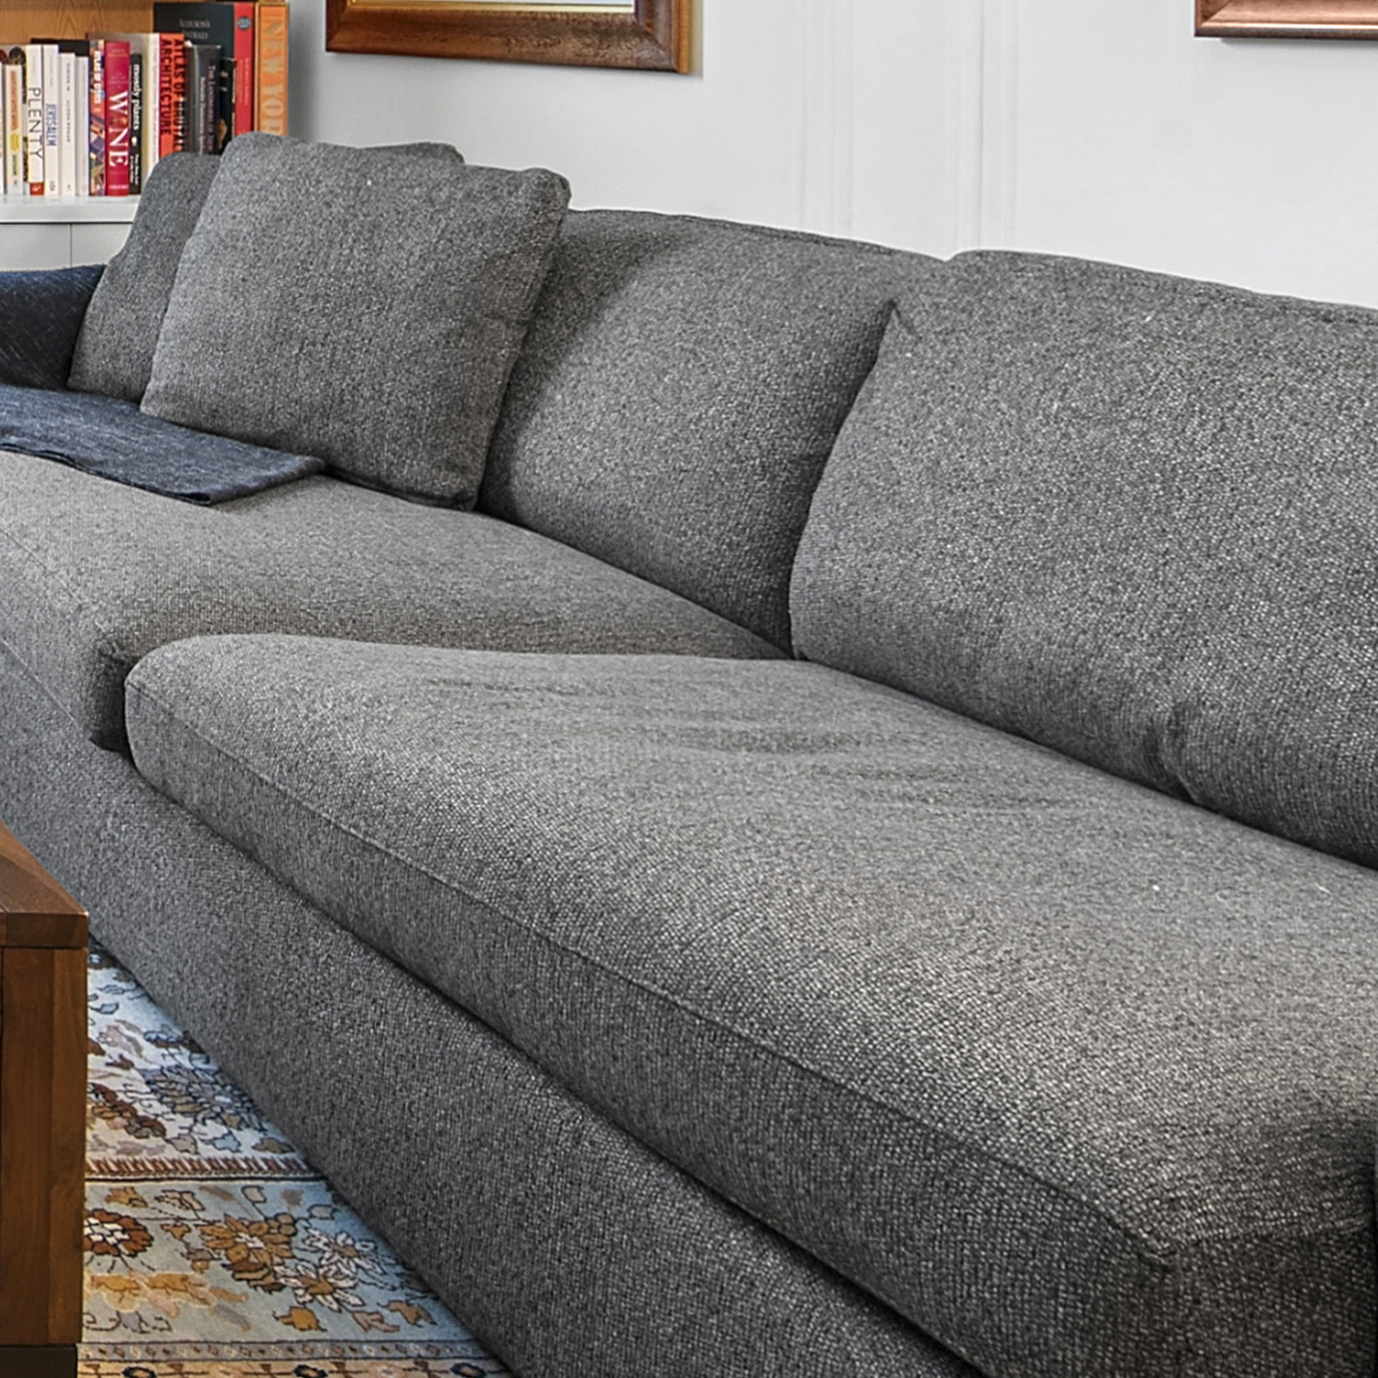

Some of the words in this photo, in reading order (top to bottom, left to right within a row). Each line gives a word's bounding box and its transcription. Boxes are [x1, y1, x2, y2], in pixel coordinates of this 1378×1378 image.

[174, 39, 183, 78] ATLAS
[261, 16, 283, 75] NEW
[132, 64, 142, 97] mostly
[161, 39, 171, 135] ARCHITECTURE
[174, 84, 182, 99] OF
[28, 87, 42, 159] PLENTY
[46, 104, 56, 146] JERUSALEM
[132, 100, 141, 130] plants
